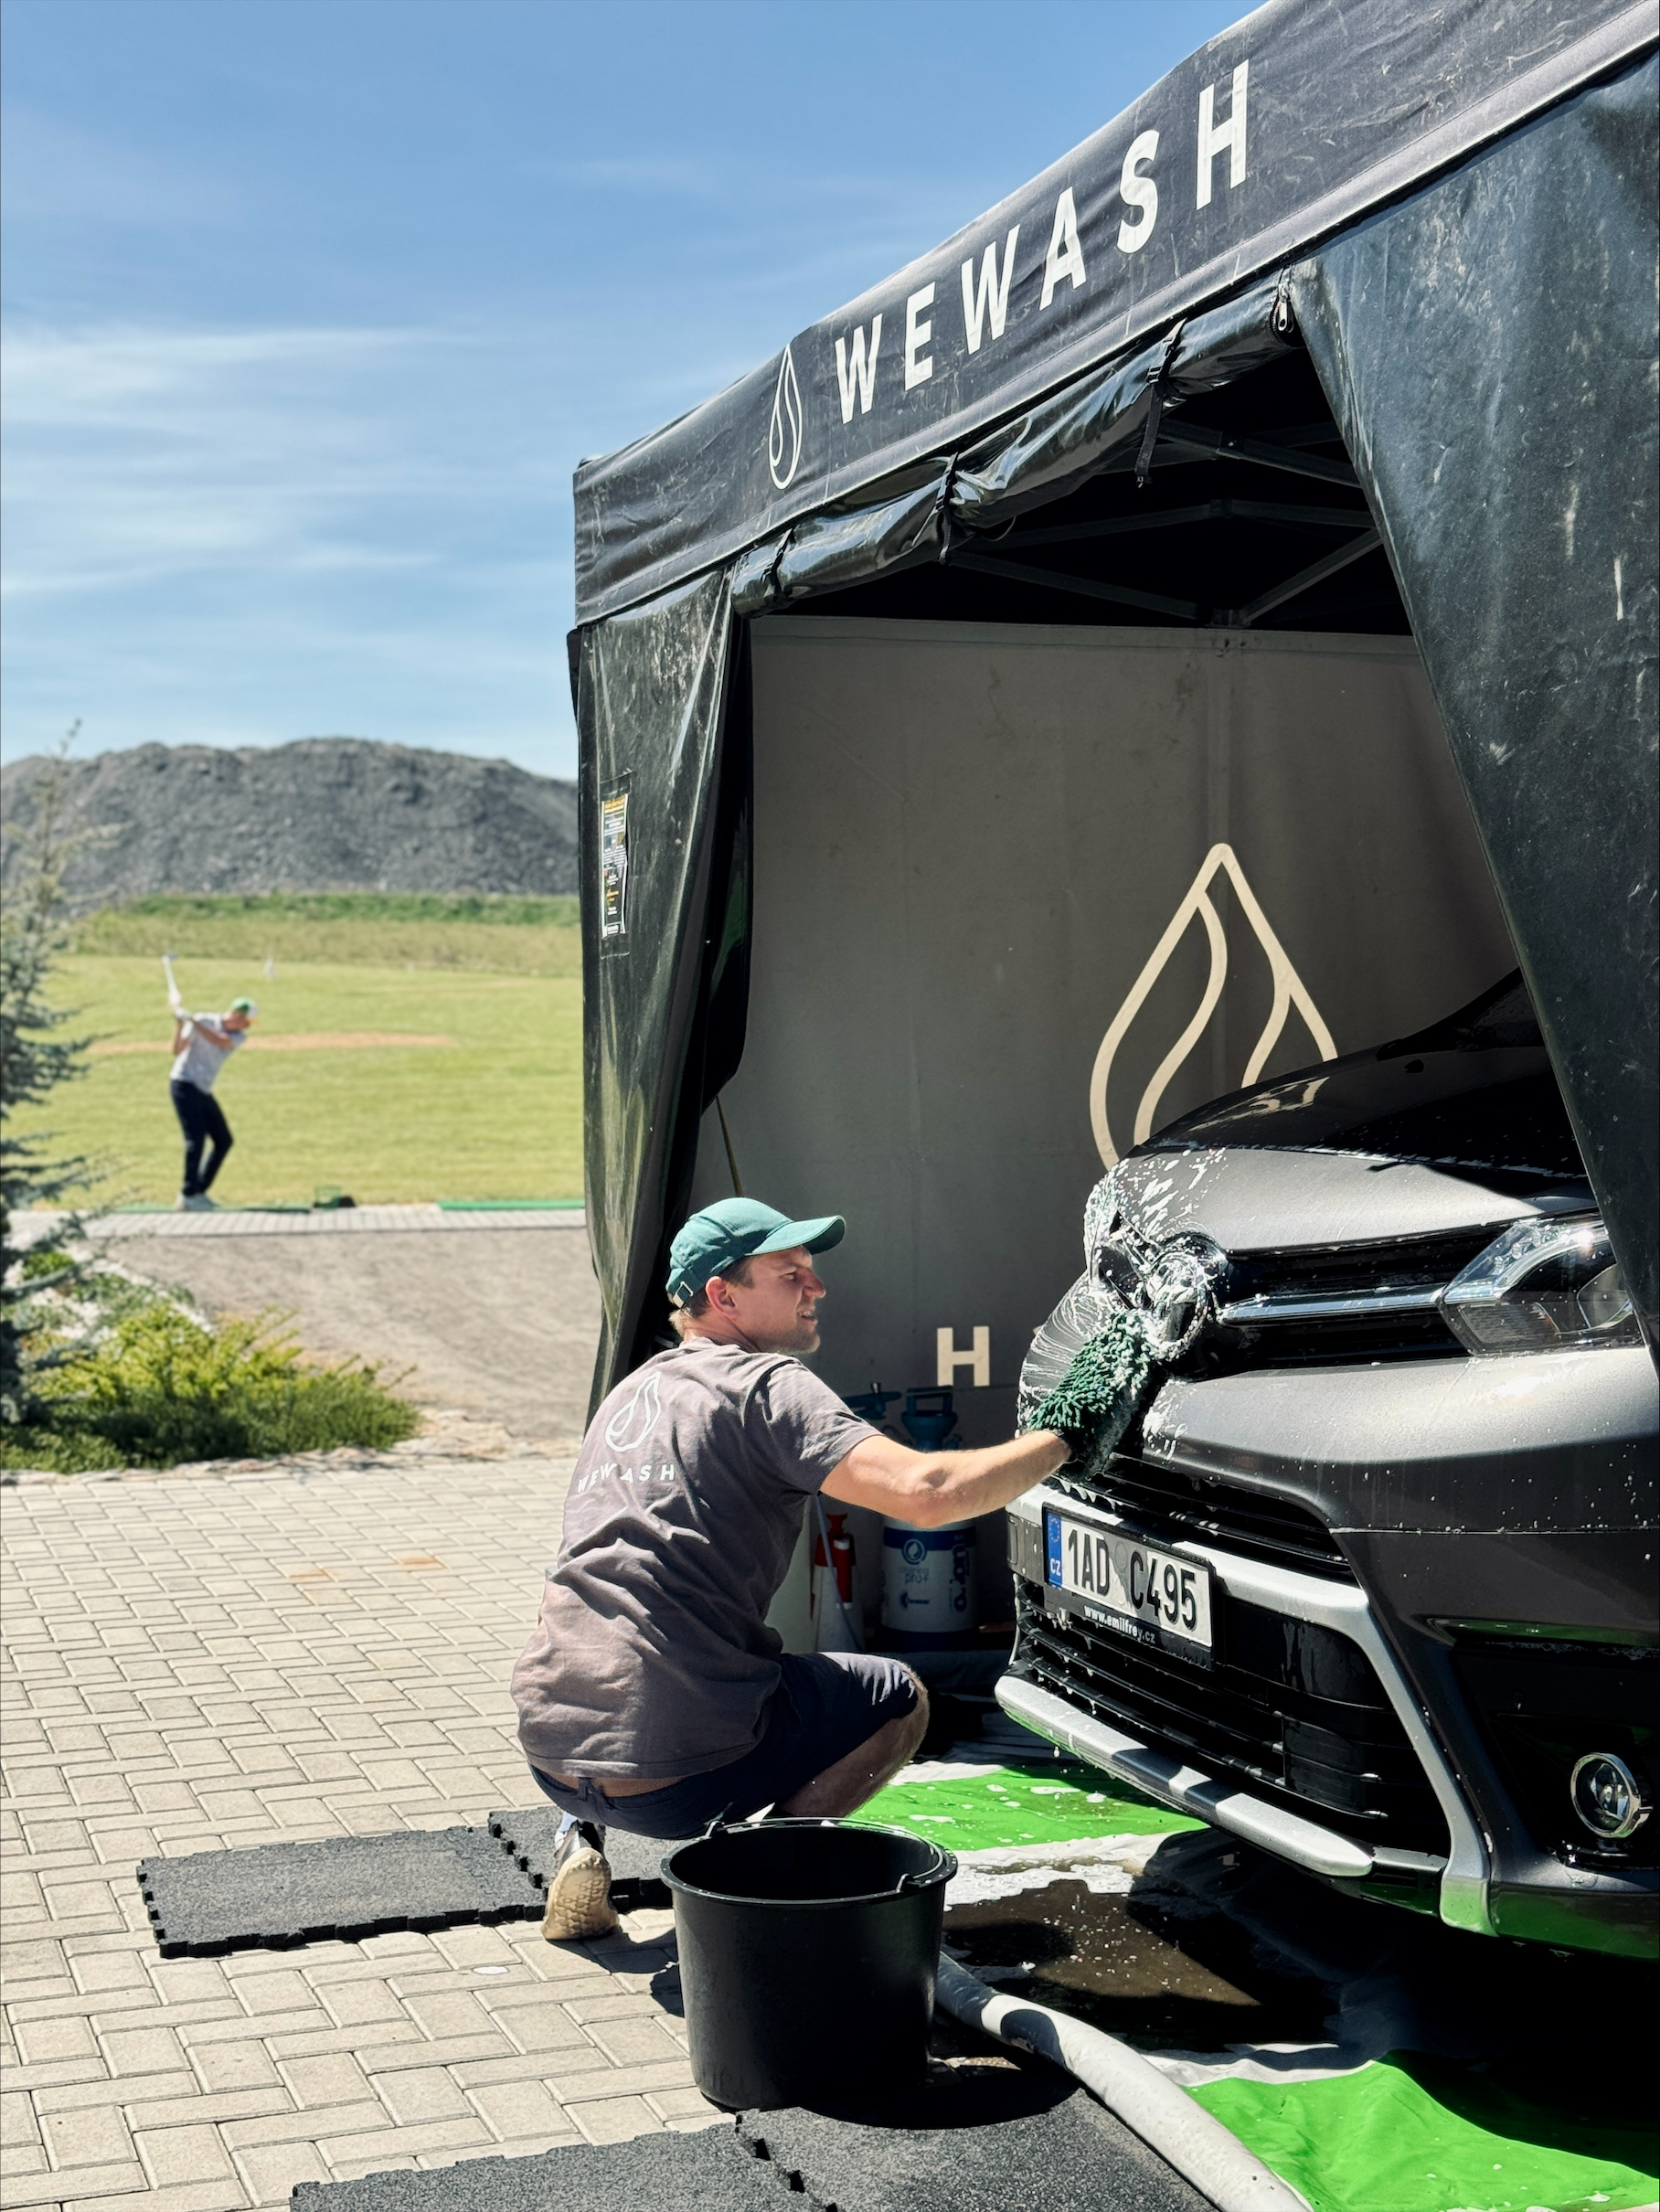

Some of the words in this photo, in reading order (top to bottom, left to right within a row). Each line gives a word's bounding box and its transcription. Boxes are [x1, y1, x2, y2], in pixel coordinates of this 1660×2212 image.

[835, 59, 1249, 424] WEWASH
[577, 1462, 676, 1494] WEWASH
[1049, 1558, 1061, 1577] CZ
[1068, 1528, 1110, 1597] 1AD
[1130, 1551, 1197, 1632] C495
[1083, 1605, 1155, 1644] www.emilfrey.cz
